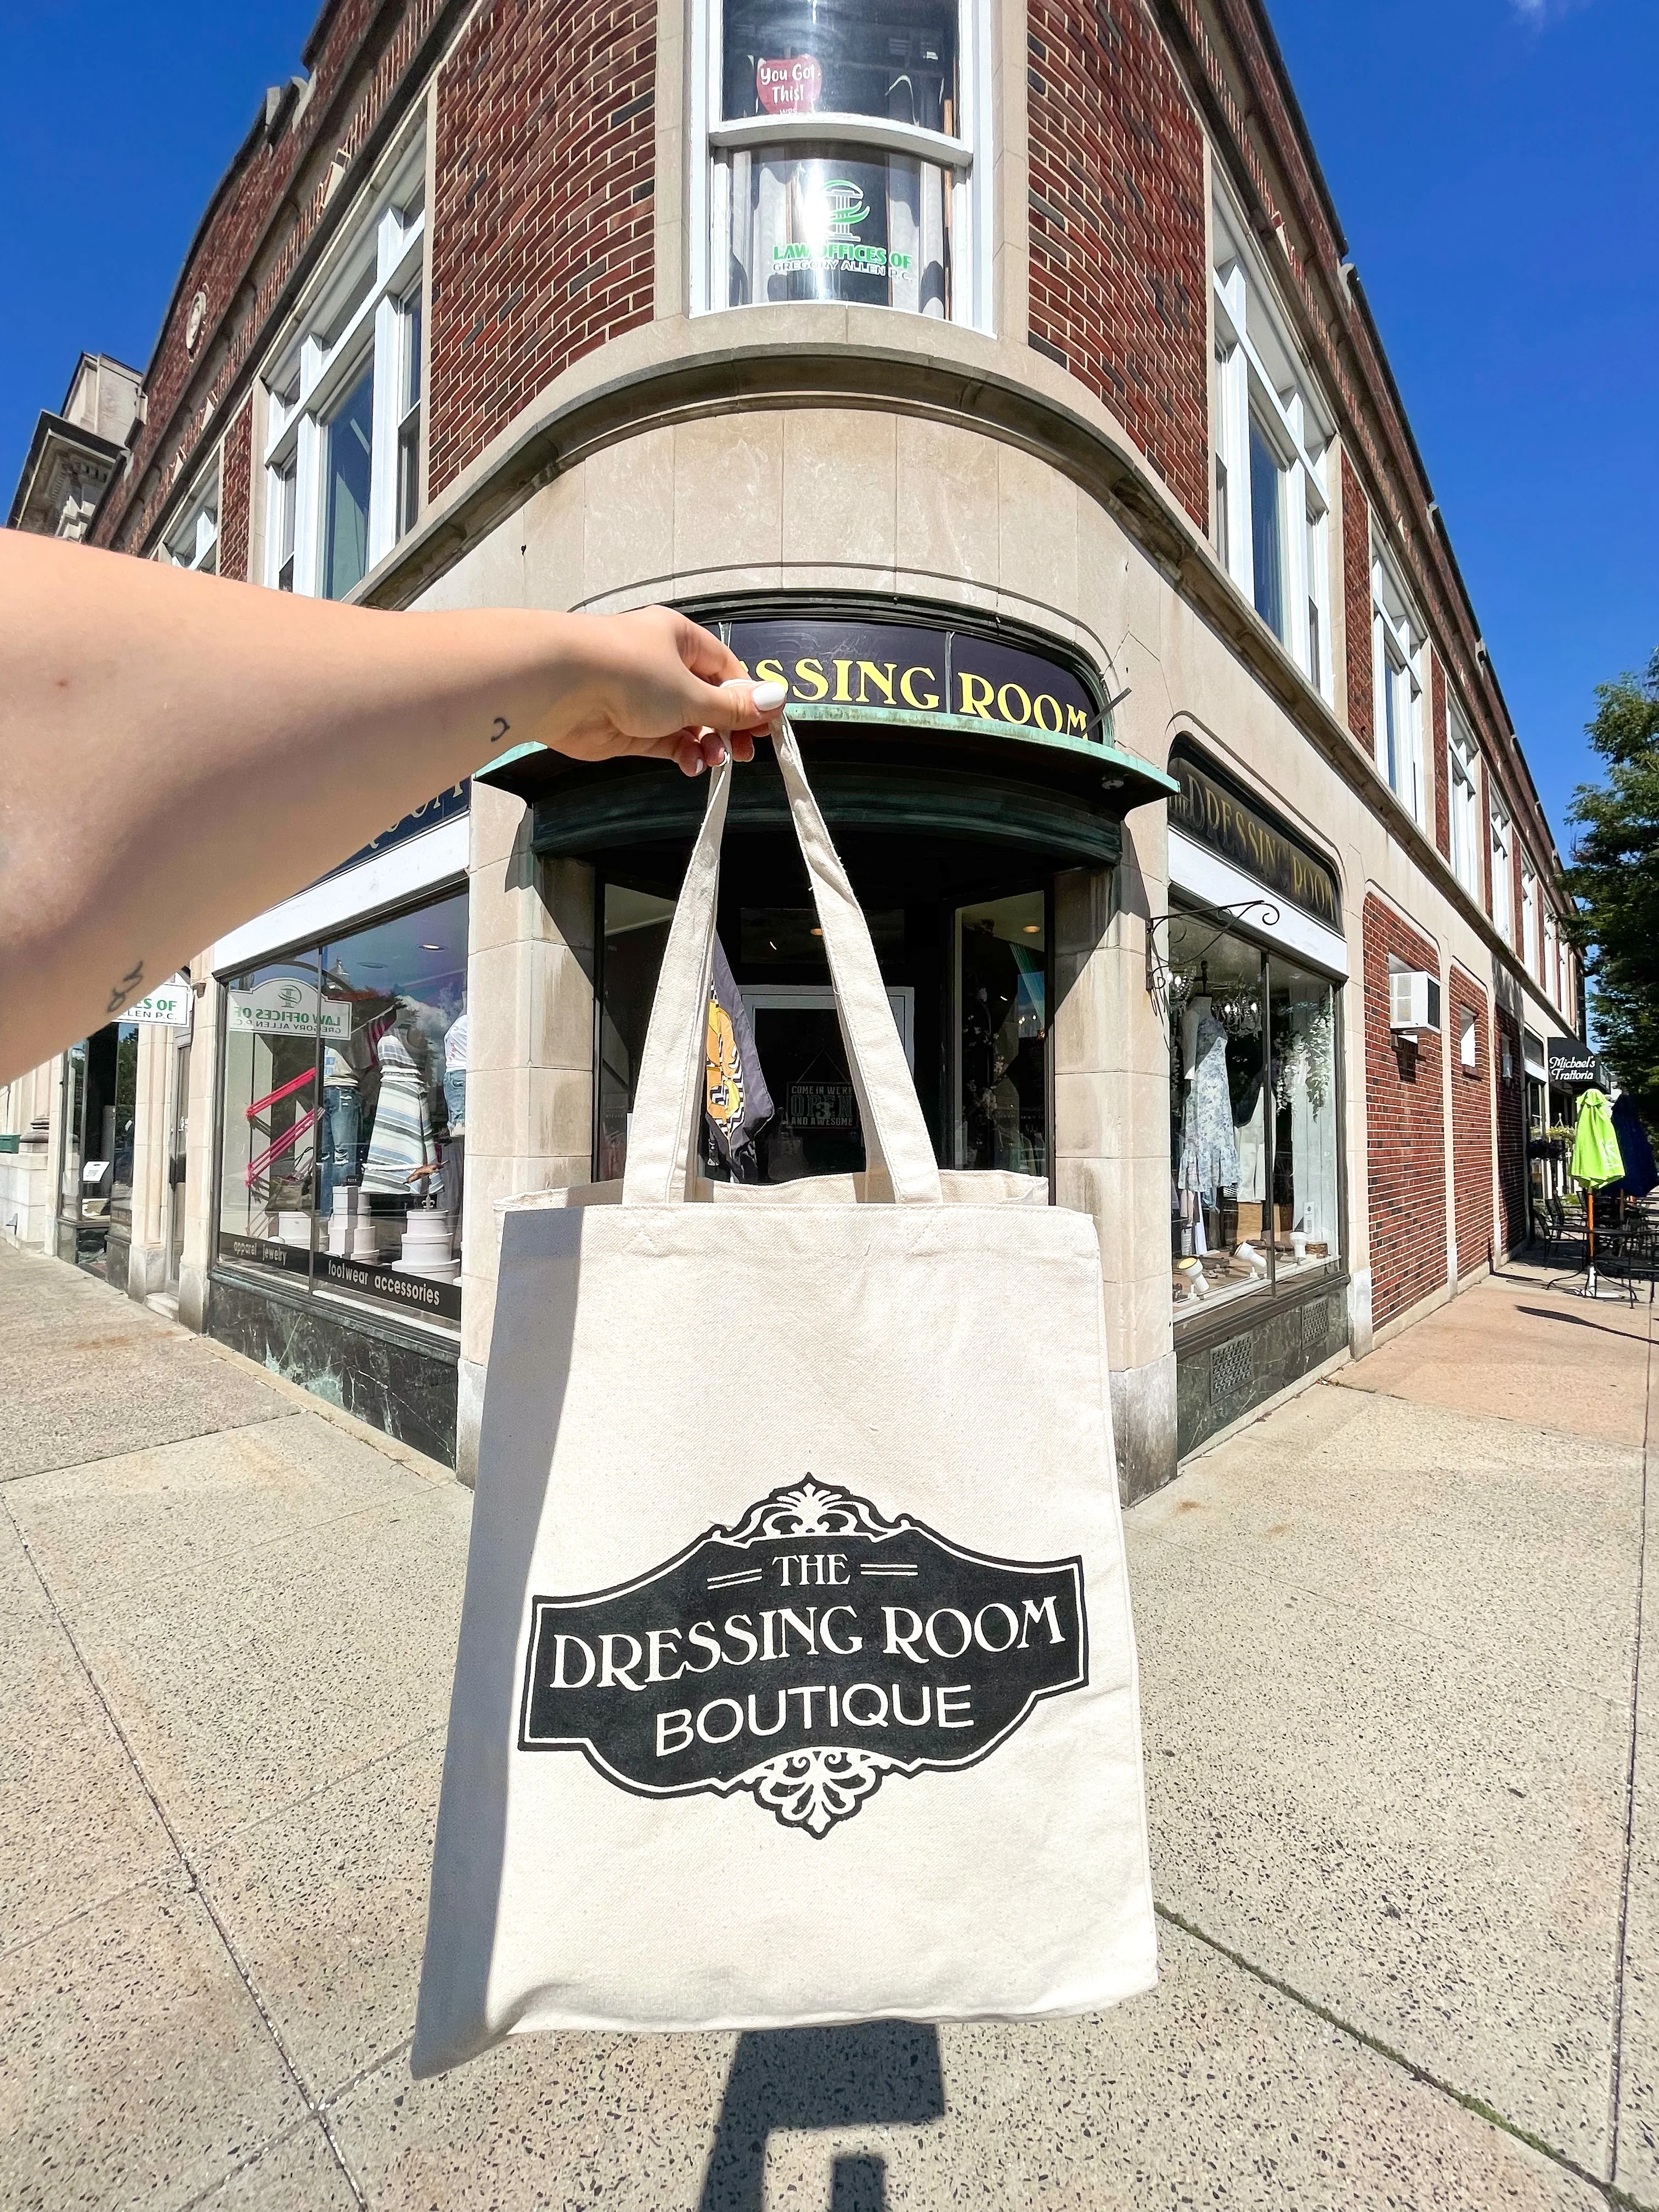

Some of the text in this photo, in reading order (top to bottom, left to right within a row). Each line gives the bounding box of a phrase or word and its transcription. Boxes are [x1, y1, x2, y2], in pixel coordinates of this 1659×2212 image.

[760, 67, 788, 86] You
[773, 244, 912, 269] LAW OFFICES OF
[772, 259, 913, 282] GREGORY ALLEN P.C.
[740, 658, 1089, 740] SSING ROOM
[123, 1009, 177, 1020] LEN P.C.
[156, 1000, 178, 1011] OF
[1549, 1056, 1596, 1069] Michael's
[1551, 1068, 1594, 1081] Trattoria
[791, 1086, 814, 1094] COME
[816, 1086, 824, 1094] IN
[791, 1116, 808, 1126] AND
[233, 1241, 257, 1256] apparel
[328, 1259, 440, 1306] footwear accessories
[772, 1553, 850, 1588] THE
[549, 1595, 1066, 1692] DRESSING ROOM
[656, 1682, 975, 1757] BOUTIQUE
